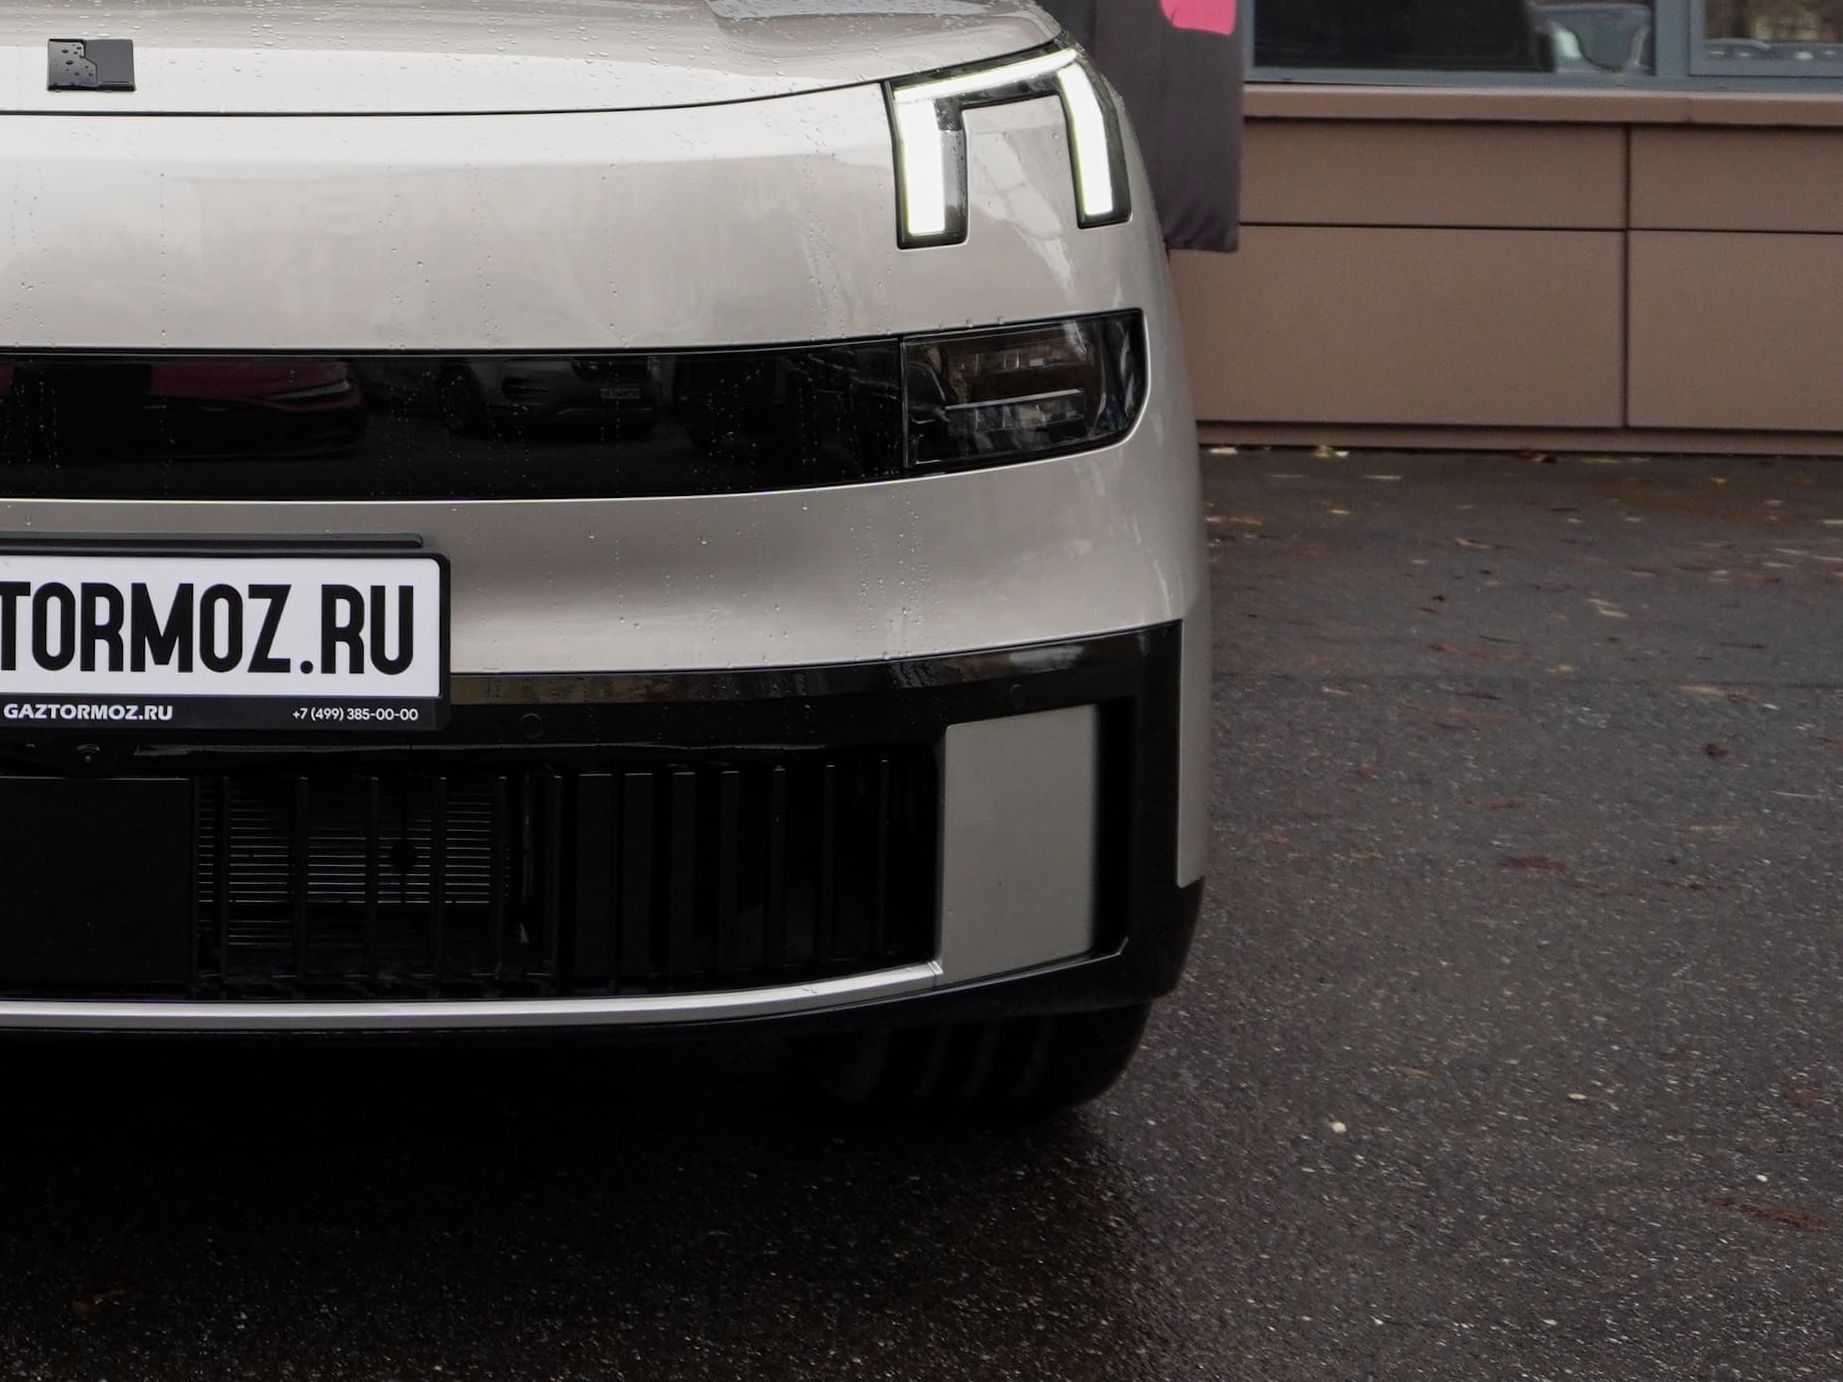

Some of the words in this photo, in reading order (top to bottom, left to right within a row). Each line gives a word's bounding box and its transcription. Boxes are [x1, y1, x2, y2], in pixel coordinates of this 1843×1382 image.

[3, 703, 174, 721] GAZTORMOZ.RU
[292, 708, 308, 719] +7
[310, 707, 344, 721] (499)
[347, 708, 419, 721] 385-00-00
